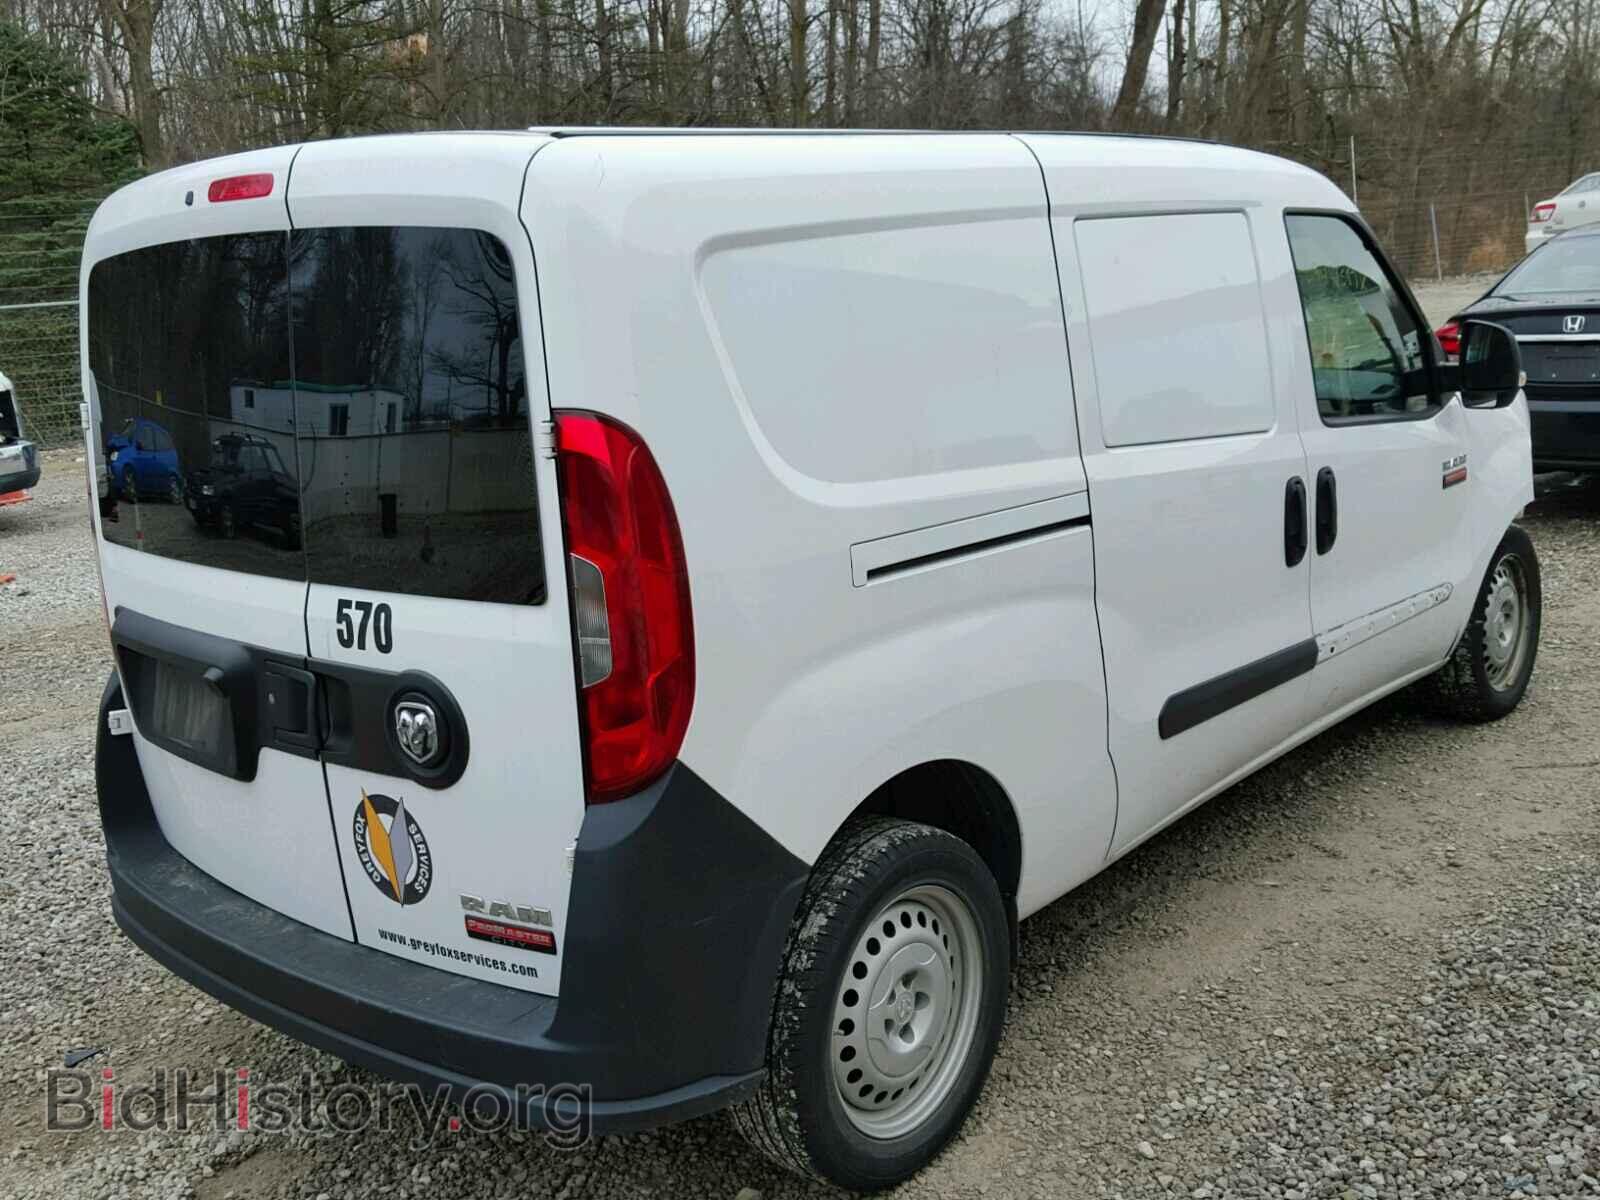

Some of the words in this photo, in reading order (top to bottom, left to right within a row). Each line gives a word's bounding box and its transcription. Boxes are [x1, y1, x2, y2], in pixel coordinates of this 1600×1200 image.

[336, 598, 393, 654] 570
[354, 813, 382, 883] GREYFOX
[408, 823, 431, 894] SERVICES
[460, 893, 553, 928] RAM
[378, 928, 539, 979] www.greyfoxservices.com
